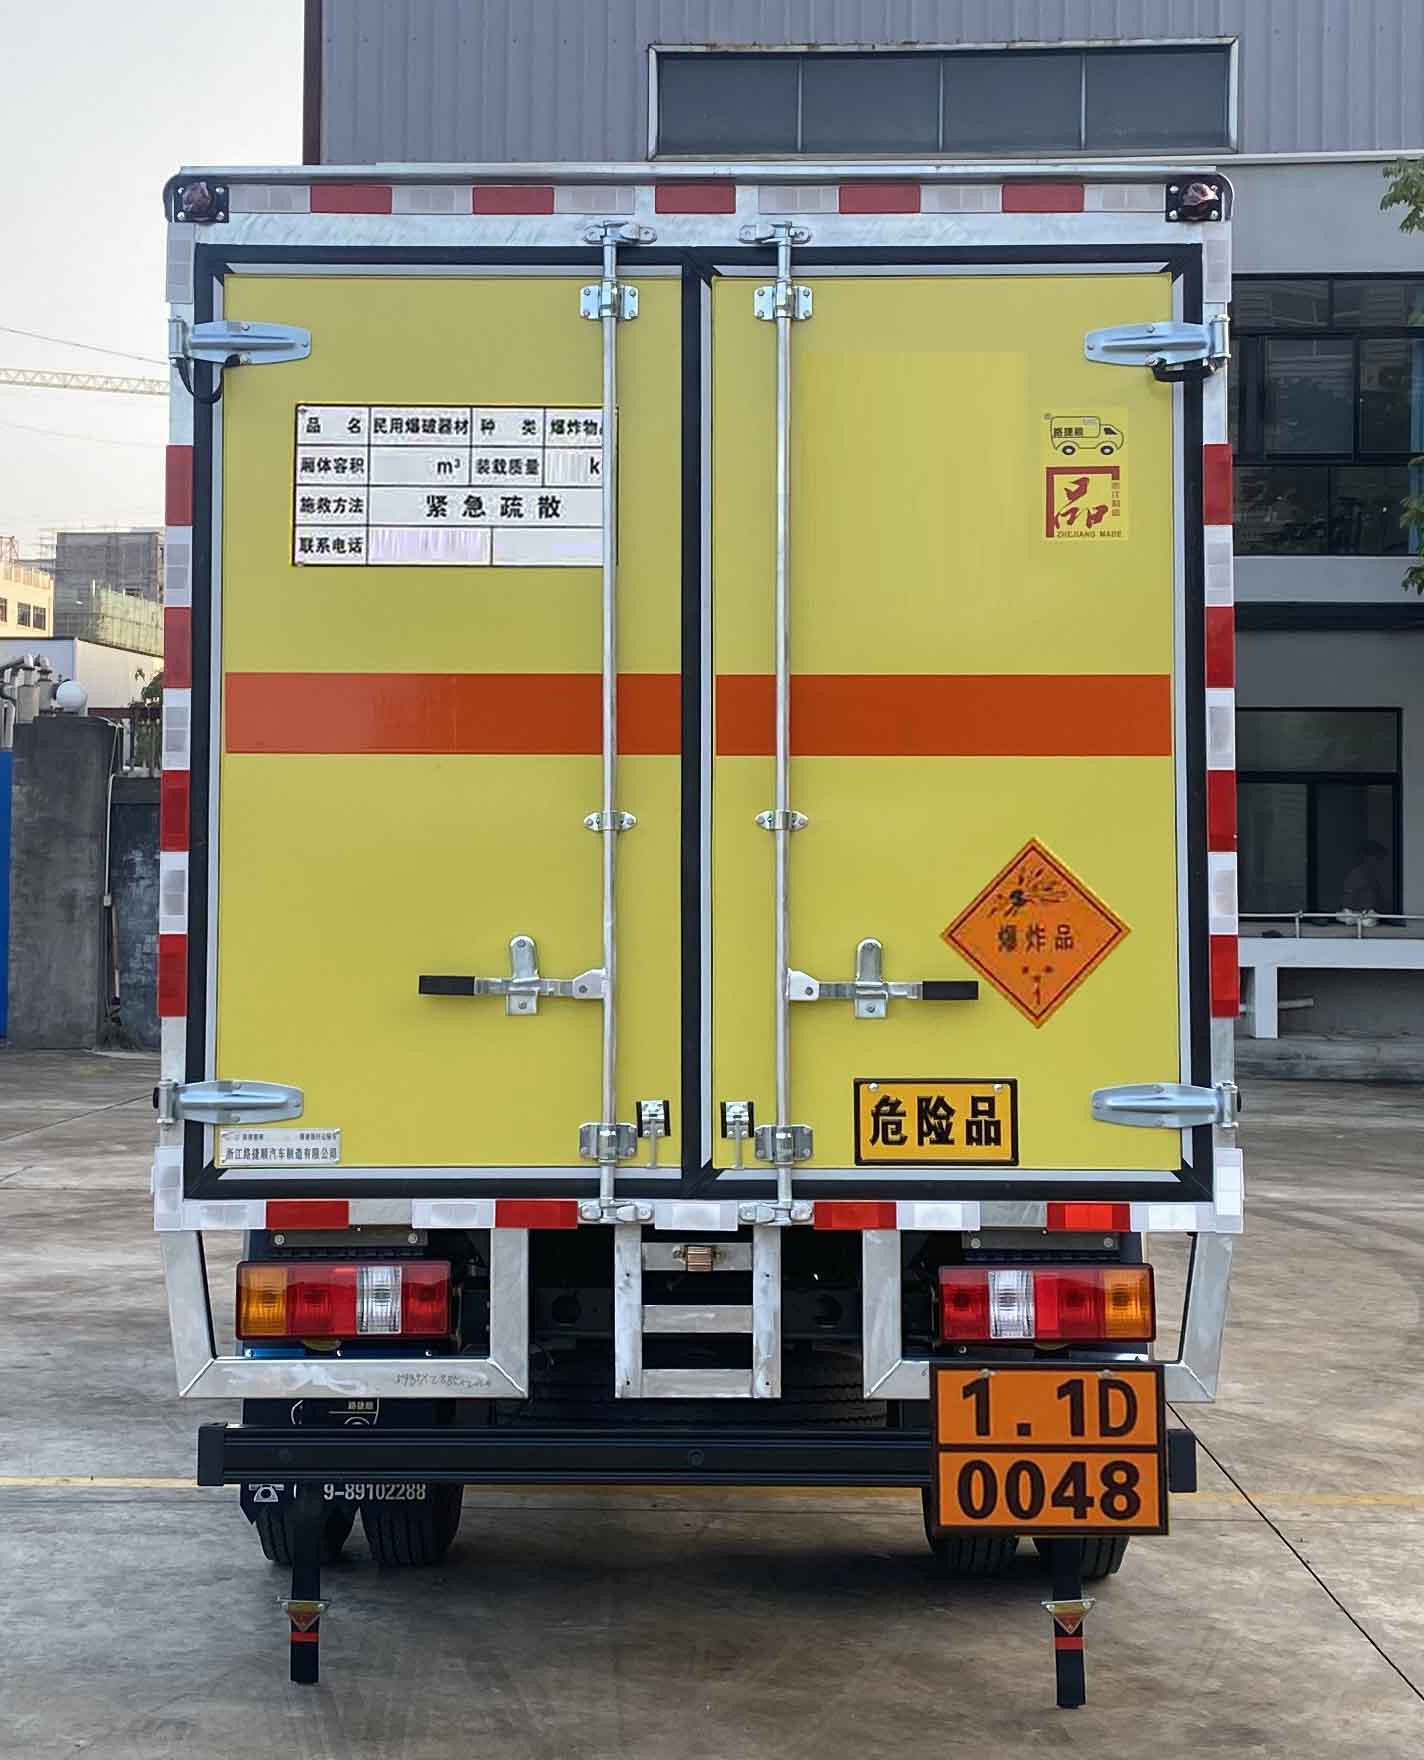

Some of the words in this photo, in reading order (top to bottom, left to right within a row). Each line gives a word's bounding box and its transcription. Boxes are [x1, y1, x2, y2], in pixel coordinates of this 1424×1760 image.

[373, 417, 469, 435] 民用爆破器材
[550, 418, 603, 436] 爆炸物
[476, 458, 540, 475] 装载质量
[300, 497, 364, 515] 施救方法
[426, 494, 561, 519] 紧急疏散
[299, 536, 364, 554] 联系电话
[997, 923, 1074, 952] 爆炸品
[869, 1094, 1002, 1147] 危险品
[957, 1459, 1141, 1520] 0048
